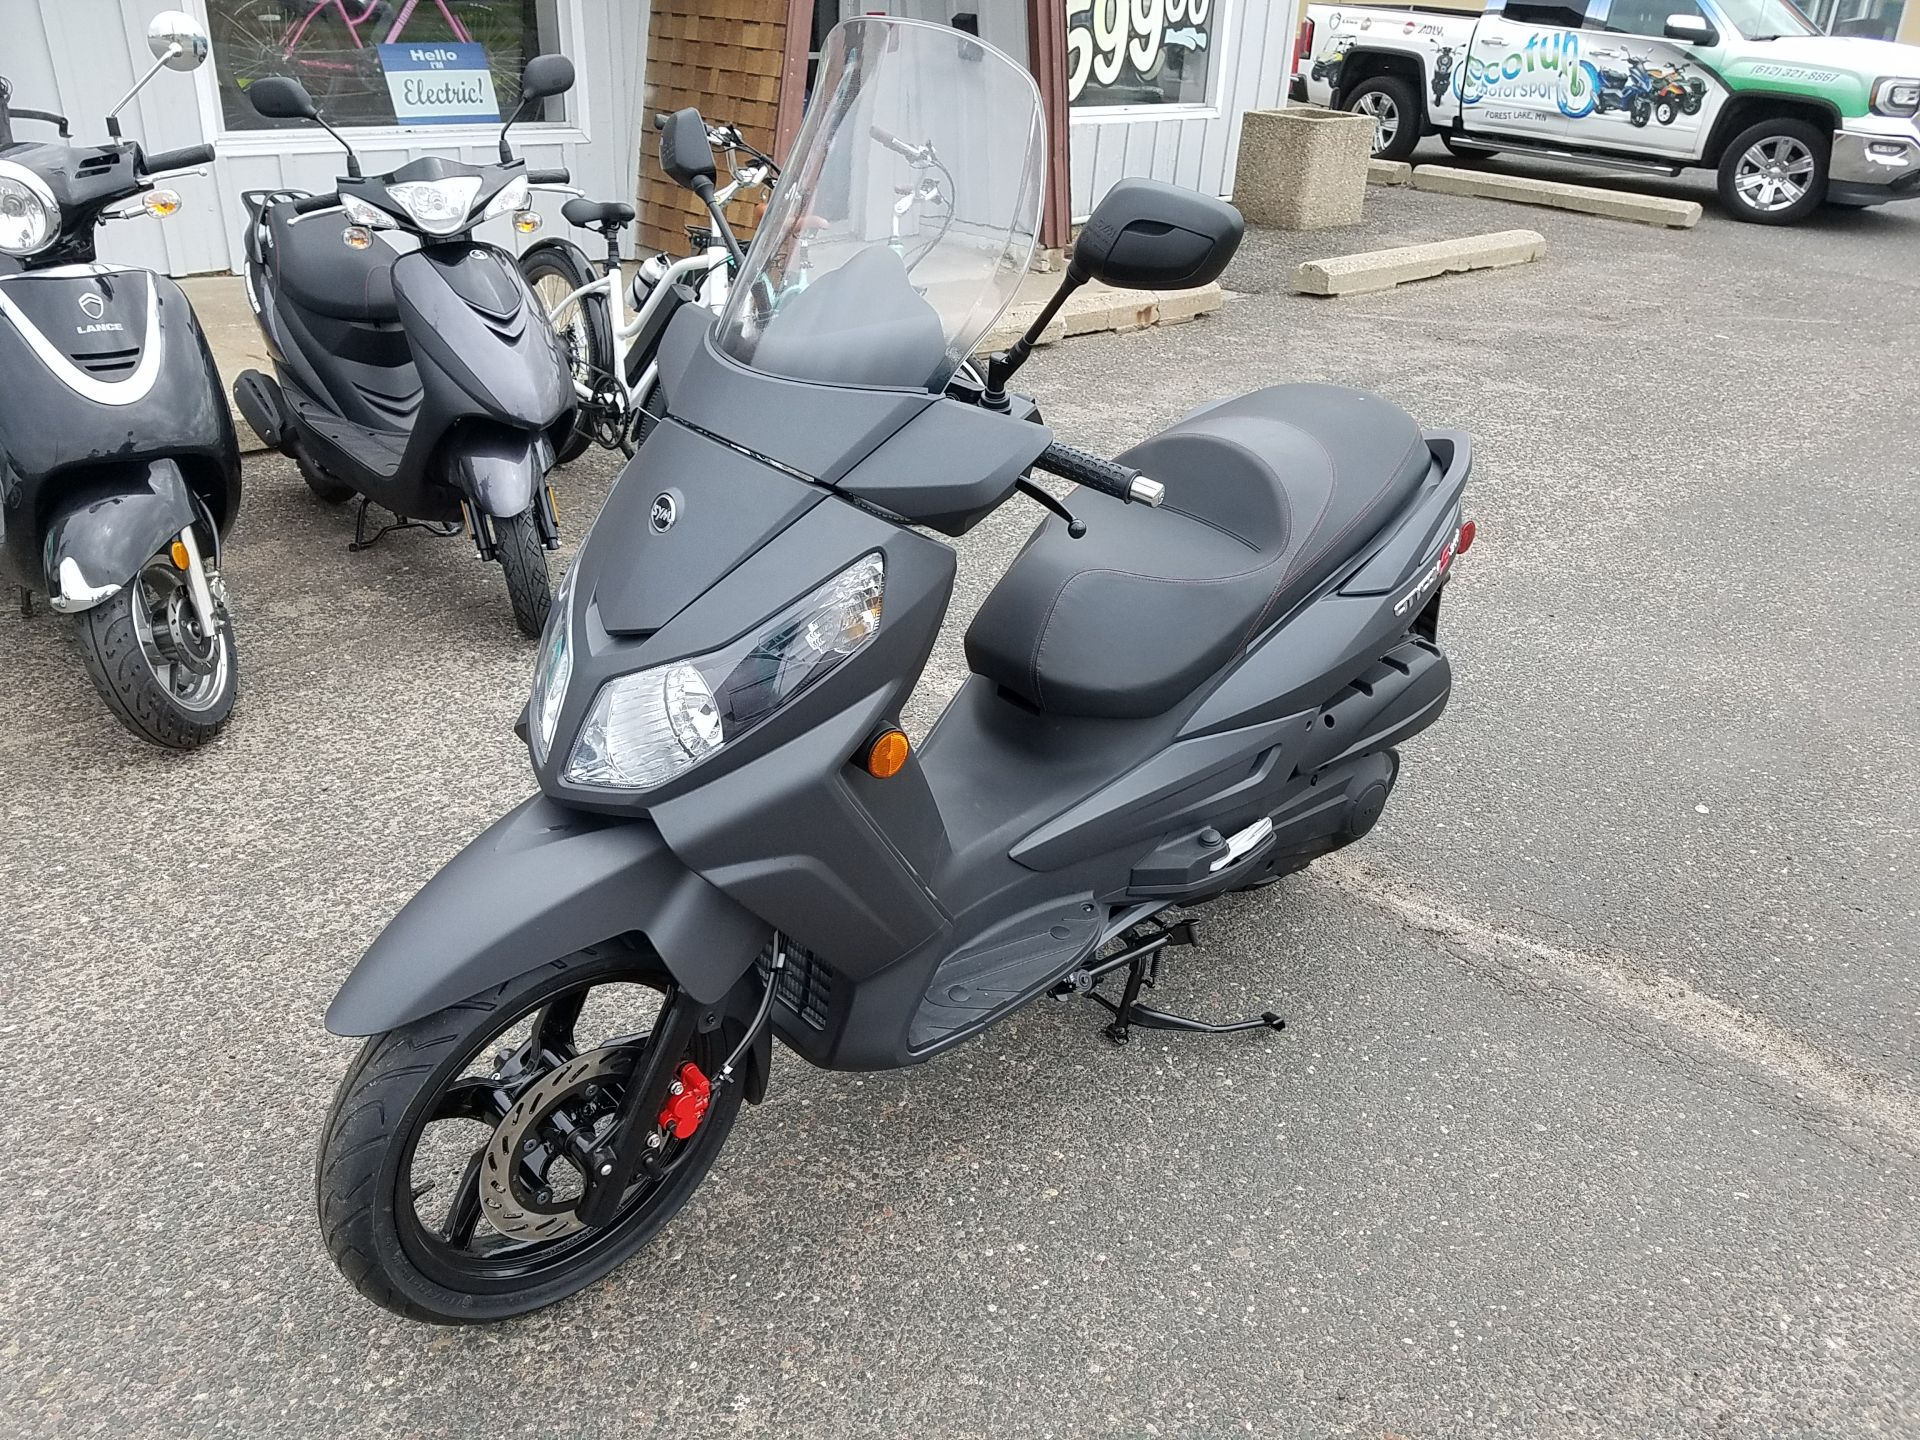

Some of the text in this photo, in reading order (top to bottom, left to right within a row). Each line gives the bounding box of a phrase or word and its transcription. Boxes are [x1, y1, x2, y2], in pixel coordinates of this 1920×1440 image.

[410, 49, 458, 61] Hello
[1750, 64, 1783, 77] (612)
[404, 78, 484, 105] Electric!
[1485, 110, 1512, 120] FOREST
[76, 322, 124, 334] LANCE
